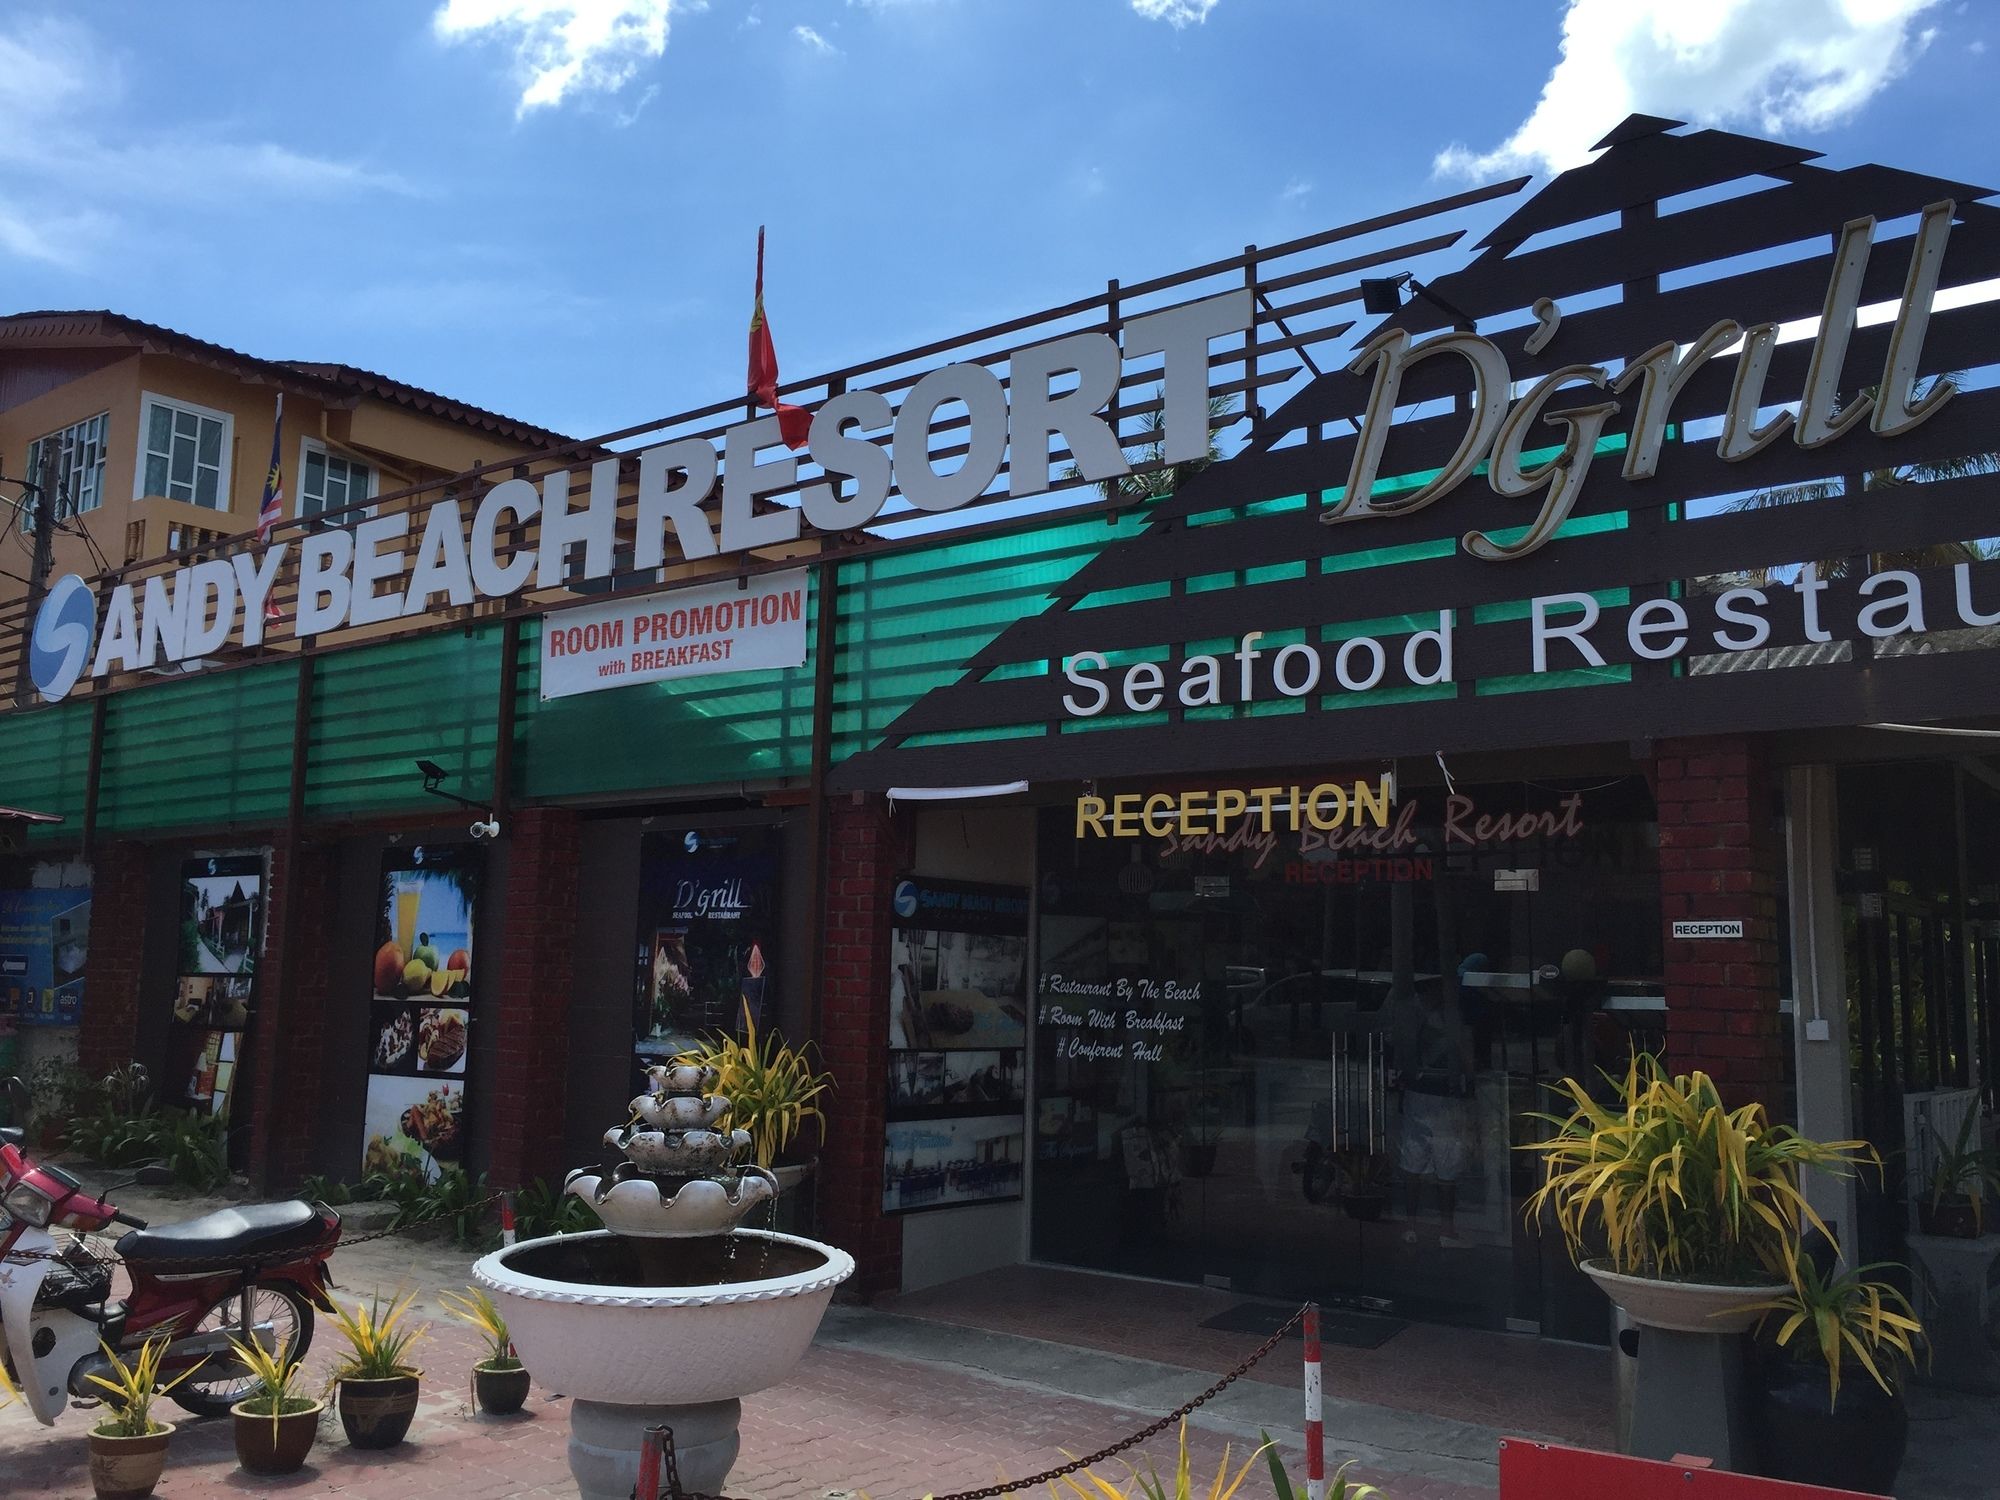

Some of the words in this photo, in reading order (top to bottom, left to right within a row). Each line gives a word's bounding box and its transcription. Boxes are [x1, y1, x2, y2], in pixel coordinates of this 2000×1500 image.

[1319, 198, 1957, 561] D'grill
[294, 458, 621, 638] BEACH
[634, 287, 1254, 572] RESORT
[550, 619, 625, 657] ROOM
[633, 590, 802, 645] PROMOTION
[598, 660, 626, 677] with
[631, 638, 734, 673] BREAKFAST
[1062, 608, 1453, 718] Seafood
[1076, 780, 1391, 839] RECEPTION
[1444, 793, 1584, 847] Resort
[1284, 857, 1433, 885] RECEPTION
[673, 878, 751, 917] D'grill
[1675, 925, 1740, 935] RECEPTION
[1049, 973, 1112, 997] Restaurant
[1116, 978, 1134, 1002] By
[1137, 978, 1160, 999] The
[1164, 980, 1201, 1000] Beach
[1050, 1005, 1083, 1026] Room
[1088, 1008, 1117, 1029] With
[1125, 1009, 1185, 1036] Breakfast
[1068, 1036, 1124, 1062] Conferent
[1132, 1040, 1163, 1062] Hall
